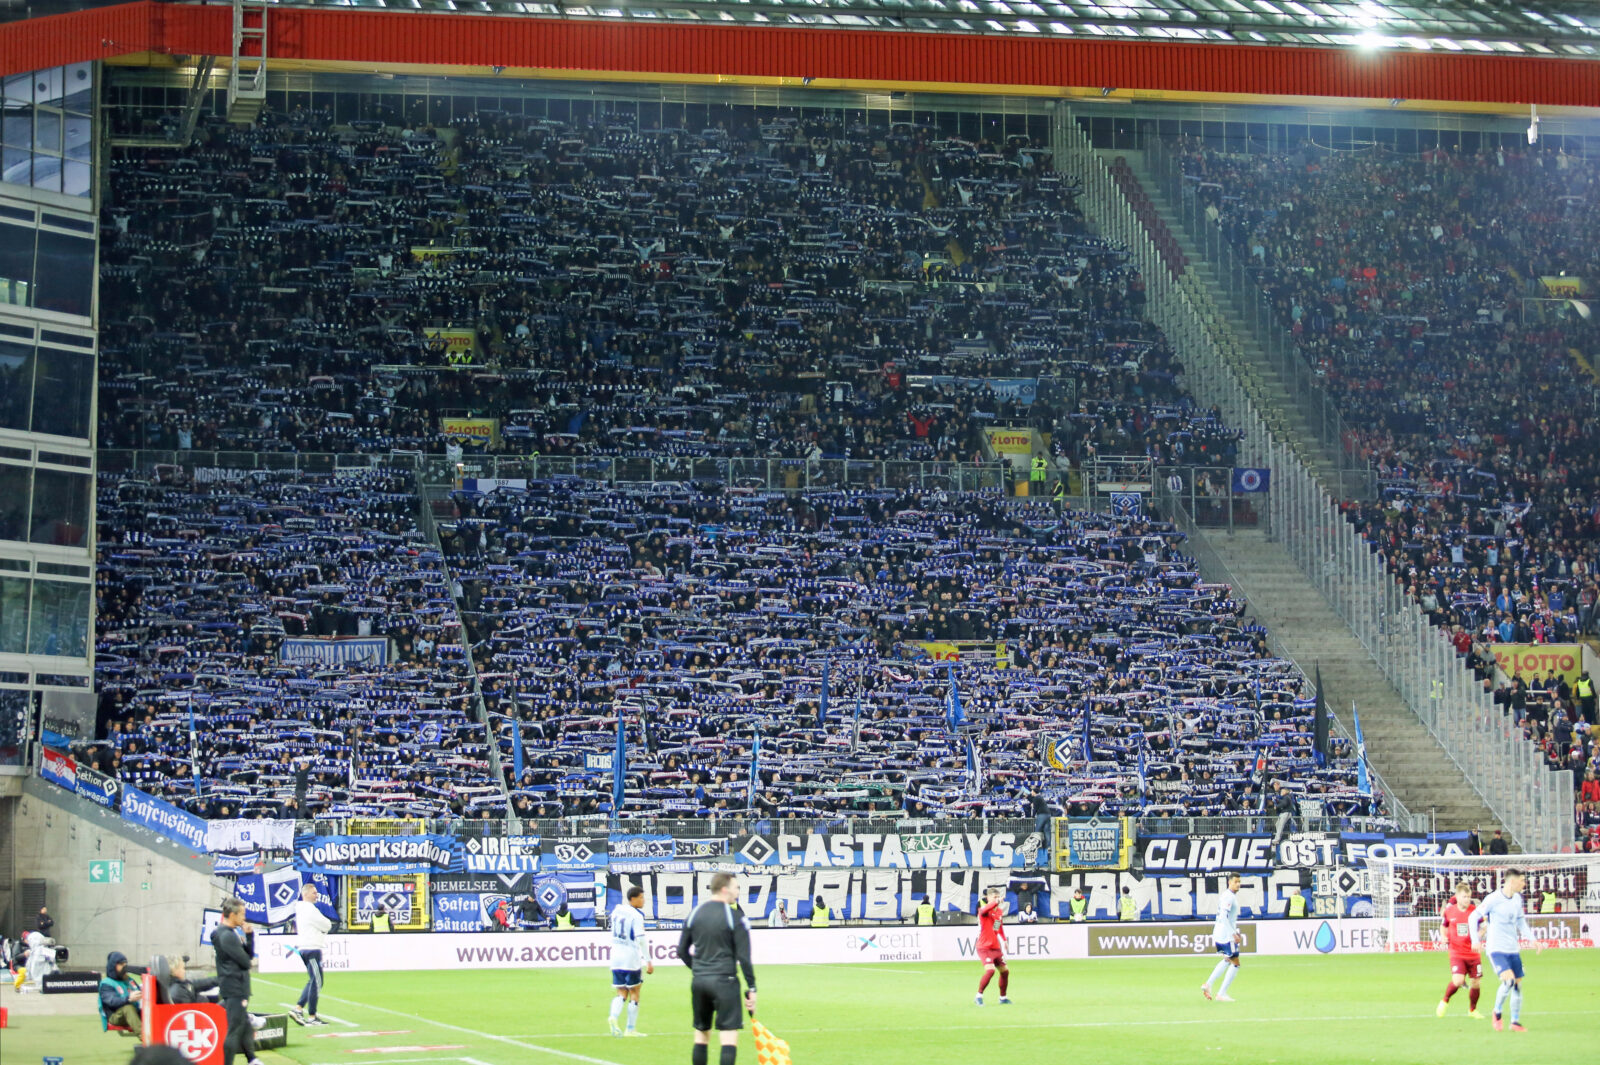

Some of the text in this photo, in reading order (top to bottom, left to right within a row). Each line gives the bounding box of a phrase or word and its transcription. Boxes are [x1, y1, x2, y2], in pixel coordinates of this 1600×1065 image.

[998, 436, 1028, 446] LOTTO
[1513, 653, 1575, 672] LOTTO
[1072, 830, 1115, 840] SEKTION
[300, 839, 451, 865] Volksparkstadion
[1073, 840, 1116, 850] STADION
[1077, 851, 1113, 861] VERBOT
[1144, 839, 1271, 871] CLIQUE
[1280, 840, 1337, 866] OST
[467, 855, 539, 871] LOYALTY
[438, 898, 478, 912] Hafen
[879, 950, 922, 961] medical
